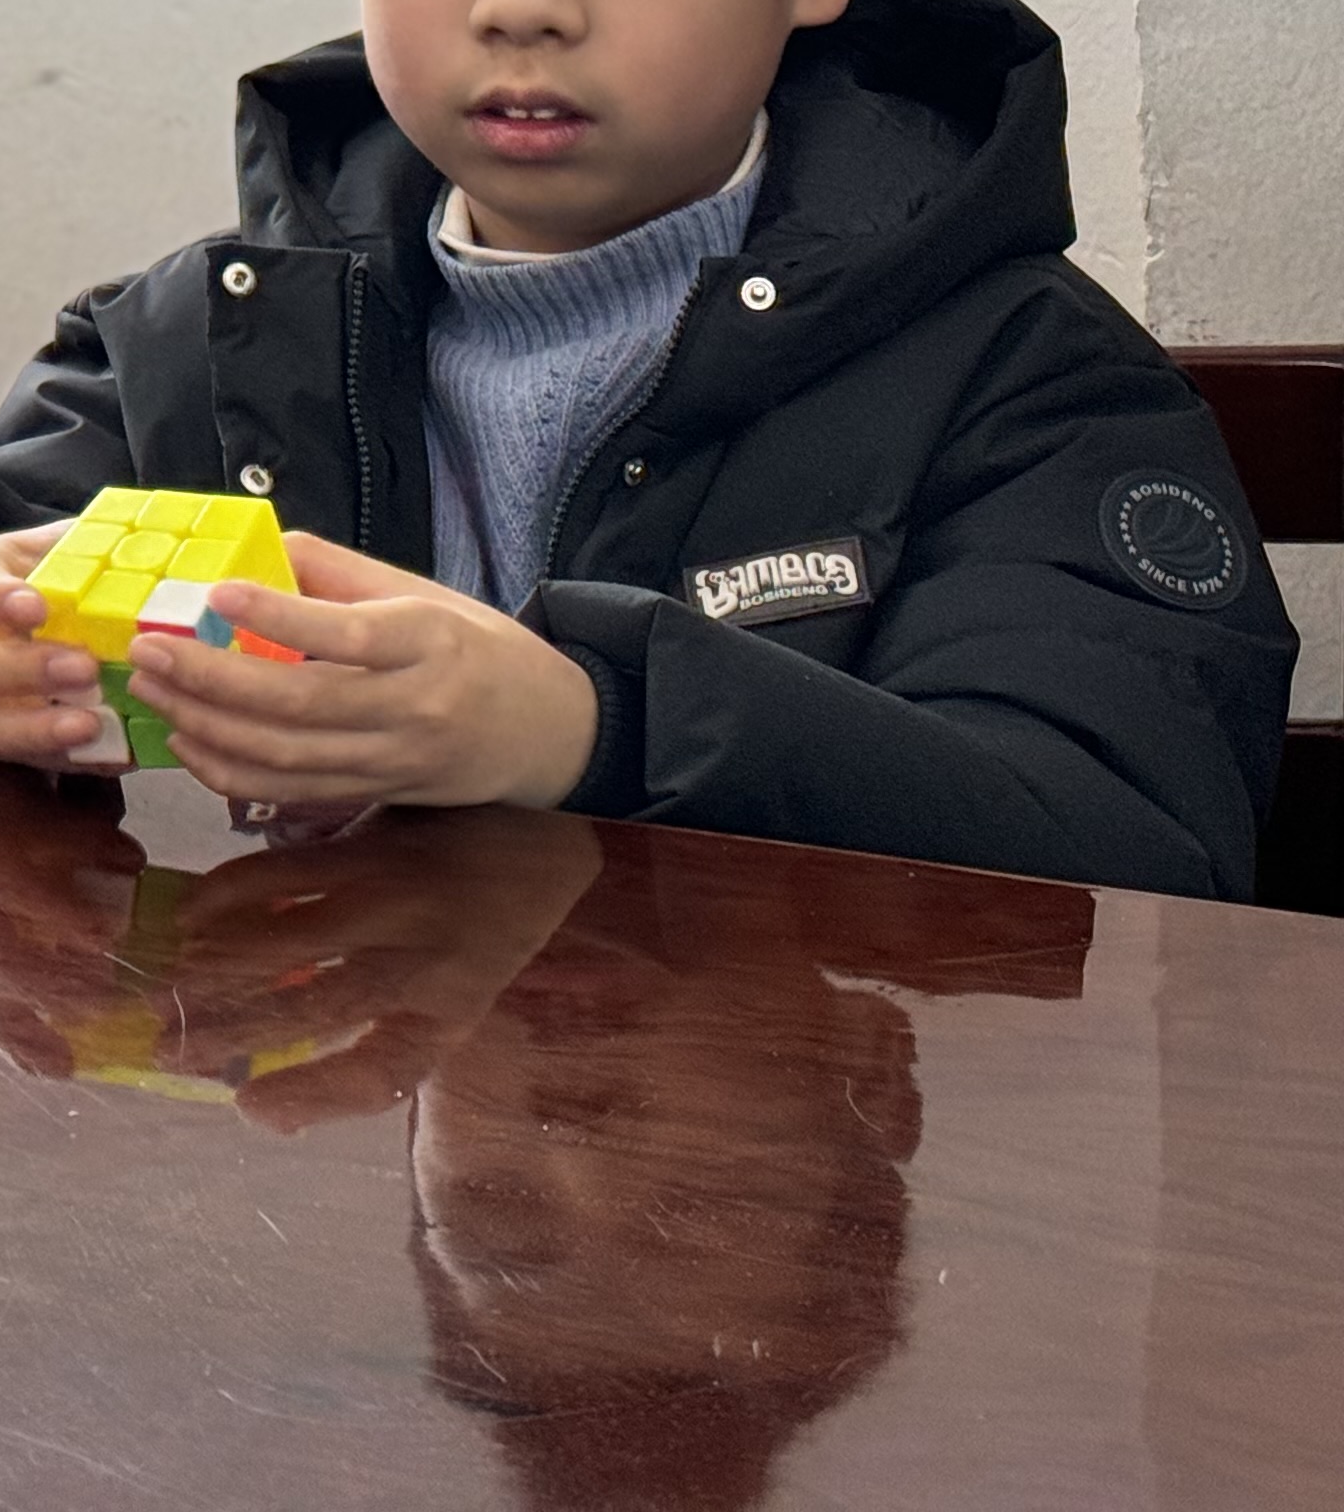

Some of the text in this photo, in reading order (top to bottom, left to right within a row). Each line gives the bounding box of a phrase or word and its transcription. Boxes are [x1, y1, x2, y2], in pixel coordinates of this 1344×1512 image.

[1130, 482, 1216, 521] BOSIDENG
[1138, 558, 1224, 595] SINCE 1976
[739, 584, 829, 611] BOSIDENG
